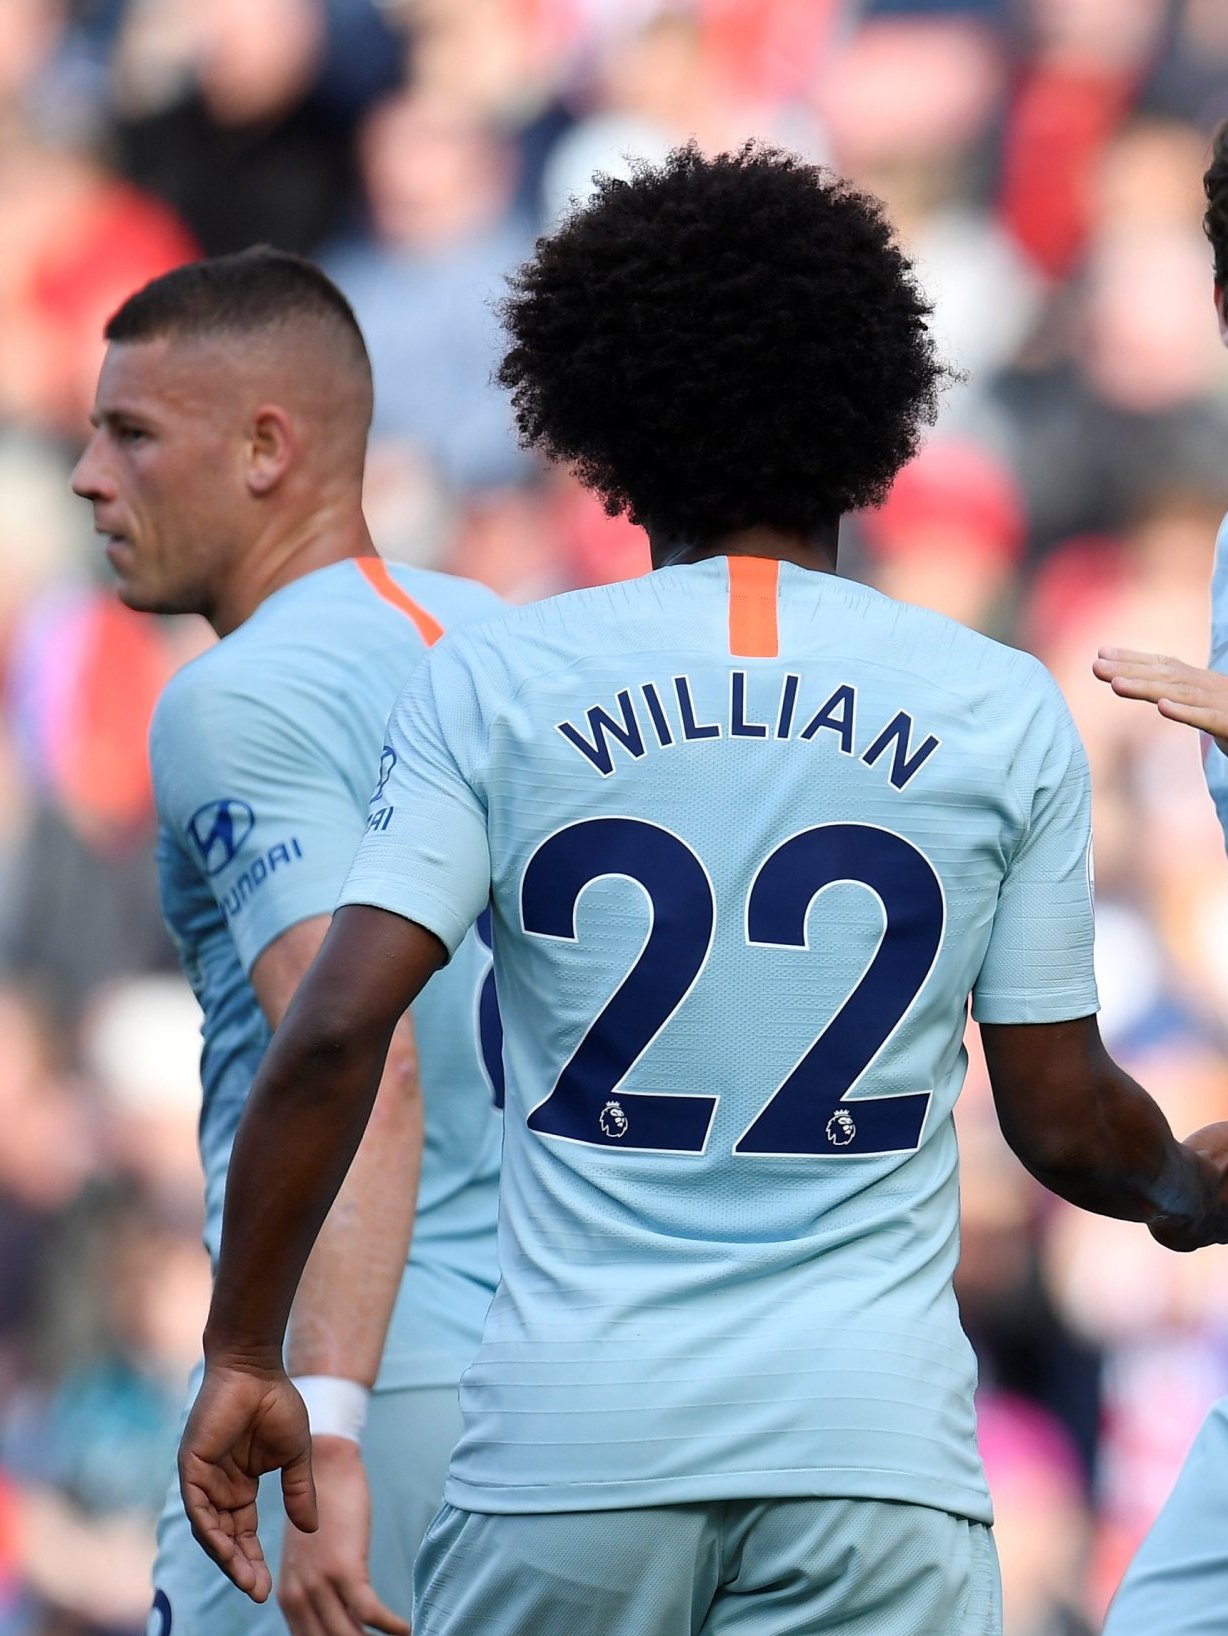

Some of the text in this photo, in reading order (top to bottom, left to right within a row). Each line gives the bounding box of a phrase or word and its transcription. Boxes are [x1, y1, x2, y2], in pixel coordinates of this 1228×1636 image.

[554, 669, 942, 793] WILLIAN
[219, 836, 302, 920] UNDAI
[519, 816, 947, 1156] 22
